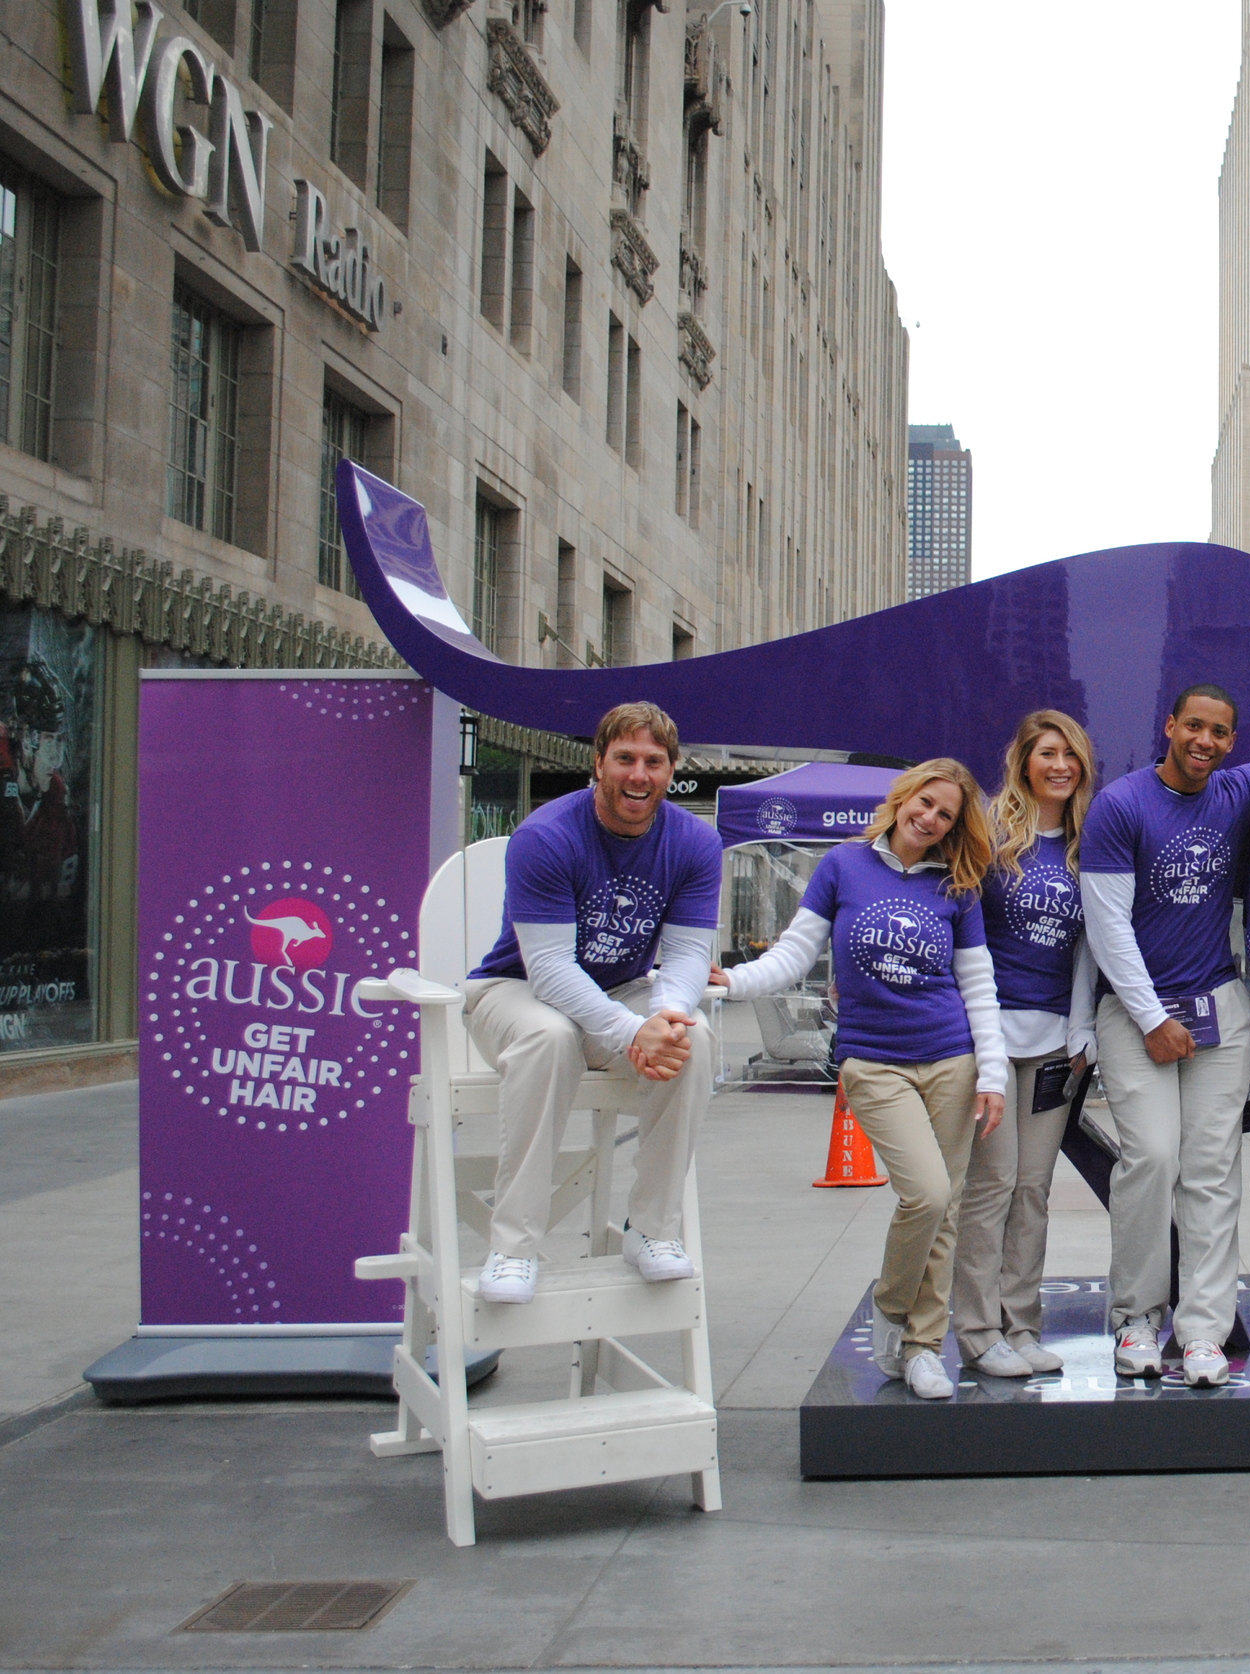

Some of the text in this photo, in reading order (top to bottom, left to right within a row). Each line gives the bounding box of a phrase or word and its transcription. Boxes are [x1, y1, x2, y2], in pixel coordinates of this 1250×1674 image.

[70, 0, 386, 333] WGN Radio
[762, 810, 793, 822] aussie
[1173, 895, 1200, 904] HAIR
[586, 911, 656, 935] aussie
[1039, 915, 1062, 928] GET
[1025, 921, 1067, 940] UNFAIR
[597, 932, 624, 948] GET
[861, 927, 938, 960] aussie
[1029, 932, 1057, 947] HAIR
[583, 951, 619, 964] HAIR
[883, 953, 909, 965] GET
[872, 961, 919, 976] UNFAIR
[881, 973, 912, 985] HAIR
[244, 1022, 316, 1053] GET
[212, 1047, 343, 1087] UNFAIR
[229, 1078, 317, 1113] HAIR
